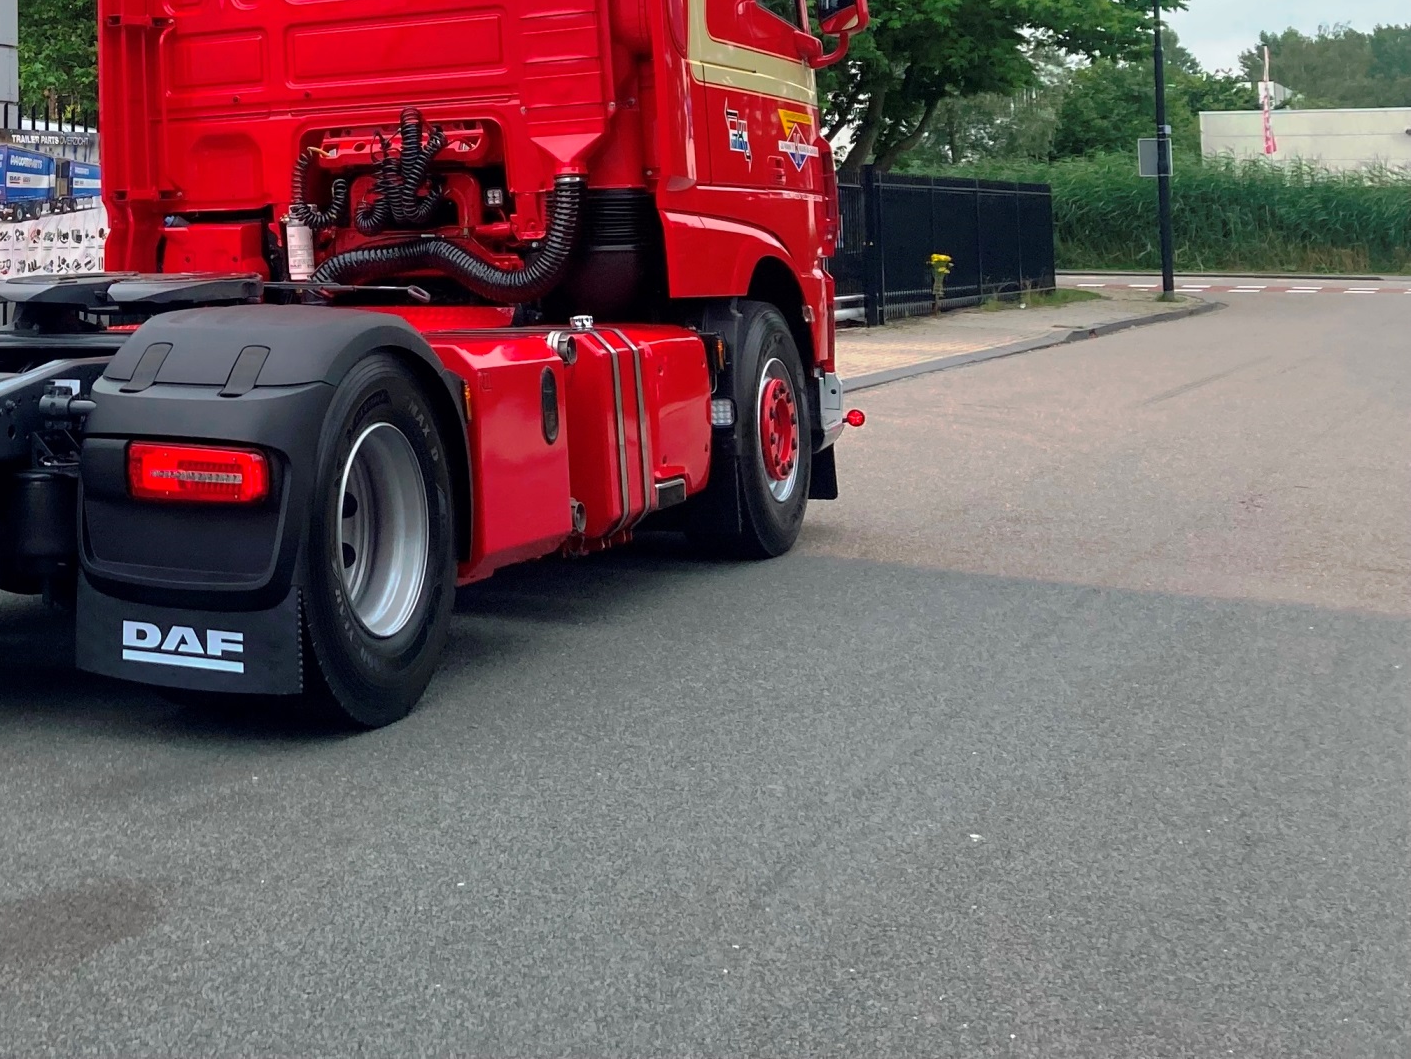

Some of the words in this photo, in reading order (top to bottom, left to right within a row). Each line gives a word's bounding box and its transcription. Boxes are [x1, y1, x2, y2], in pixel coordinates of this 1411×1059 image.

[11, 134, 40, 144] TRAILER
[40, 135, 60, 145] PARTS
[122, 620, 244, 656] DAF
